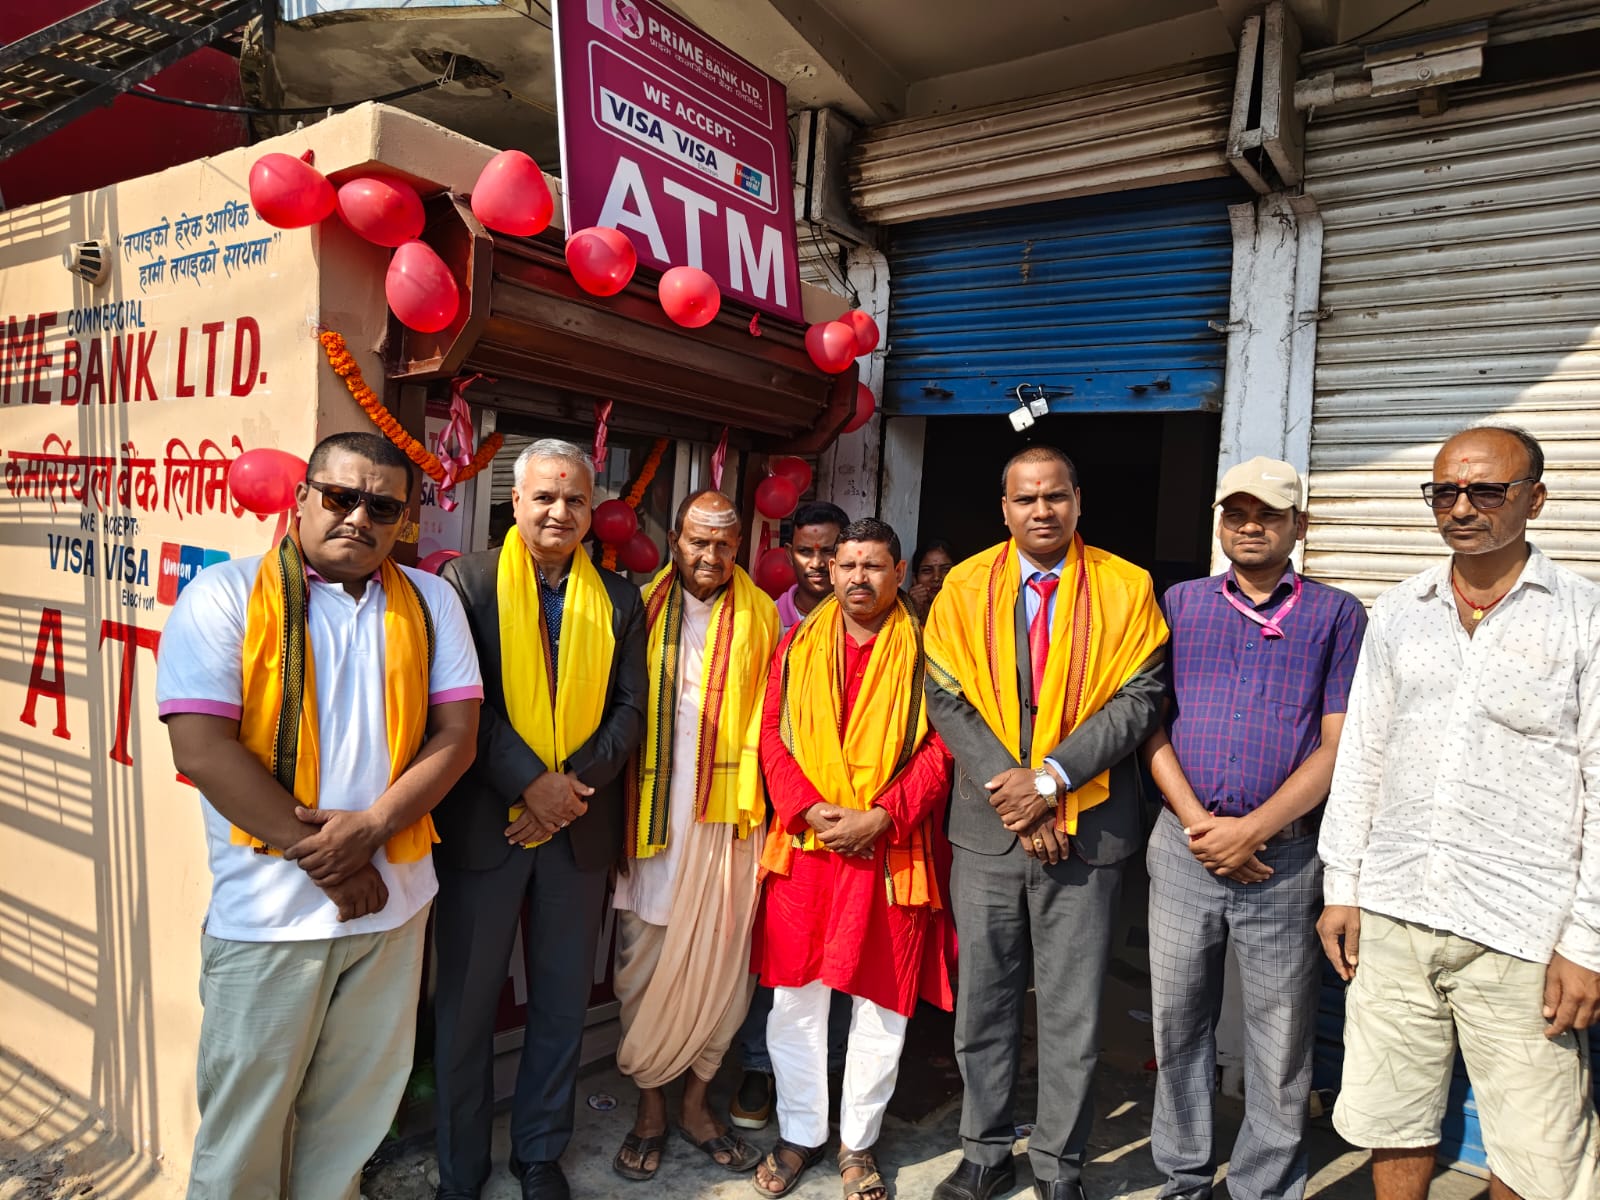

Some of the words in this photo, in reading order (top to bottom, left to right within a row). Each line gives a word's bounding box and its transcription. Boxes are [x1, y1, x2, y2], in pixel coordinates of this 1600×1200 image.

[705, 58, 738, 88] BANK
[741, 79, 763, 102] LTD.
[606, 93, 665, 144] VISA
[673, 129, 718, 170] VISA
[643, 81, 671, 111] WE
[675, 101, 736, 147] ACCEPT:
[175, 212, 203, 249] हरेक
[205, 200, 249, 235] आर्थिक
[597, 156, 787, 308] ATM
[139, 255, 166, 294] हामी
[67, 299, 145, 336] COMMERCIAL
[60, 329, 159, 406] BANK
[176, 316, 267, 397] LTD.
[80, 512, 95, 533] WE
[48, 533, 95, 577] VISA
[103, 542, 149, 587] VISA
[20, 607, 197, 788] AT
